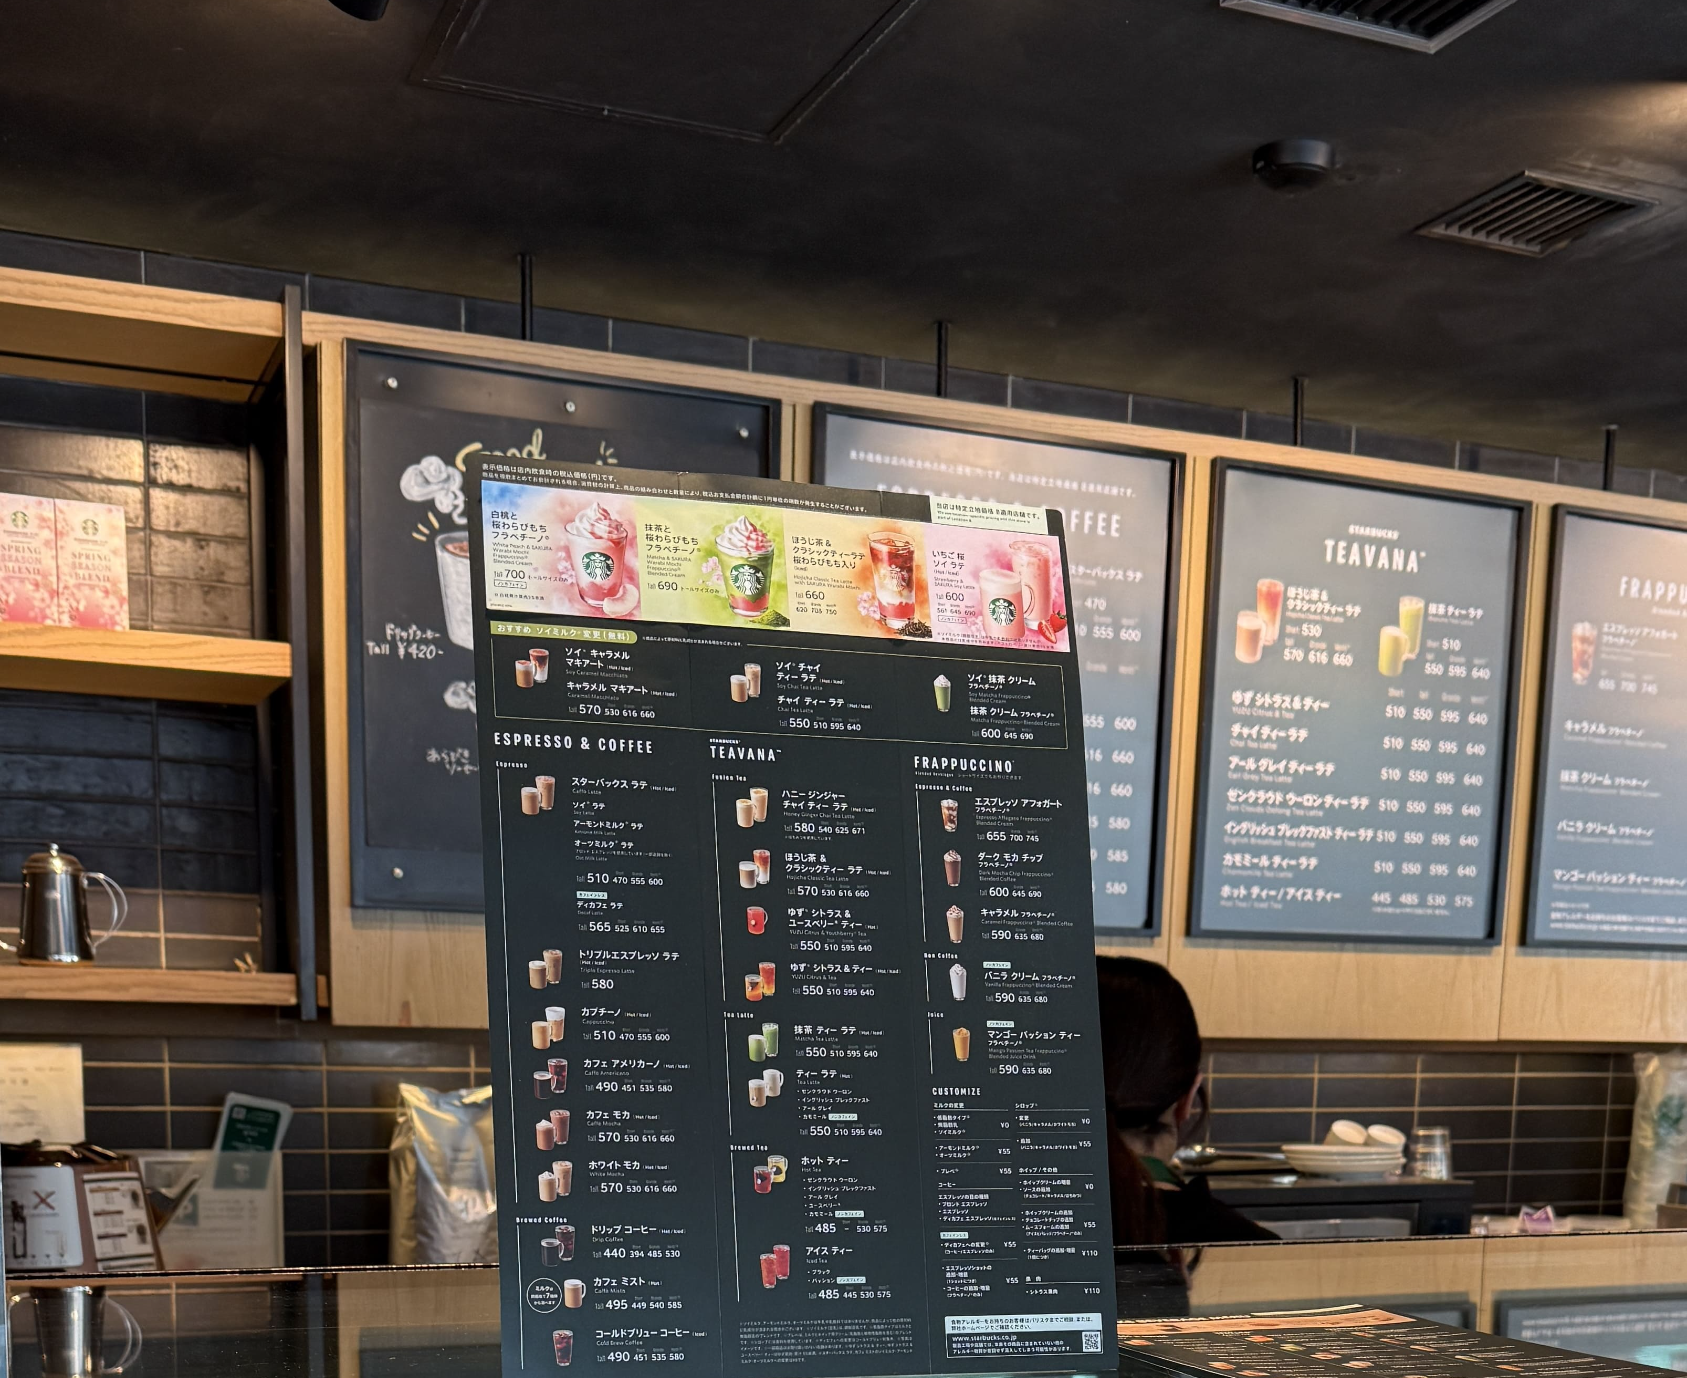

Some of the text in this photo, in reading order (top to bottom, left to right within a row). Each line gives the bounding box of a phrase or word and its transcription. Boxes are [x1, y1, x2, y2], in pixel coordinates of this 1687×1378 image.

[491, 511, 517, 520] 白桃と
[491, 521, 547, 533] 桜わらびもち
[645, 524, 670, 534] 抹茶と
[646, 534, 699, 545] 桜わらびもち
[792, 536, 823, 546] ほうじ茶
[793, 556, 856, 568] 桜わらびもち入り
[505, 570, 525, 579] 700
[658, 582, 678, 591] 690
[805, 591, 825, 600] 660
[946, 592, 964, 601] 600
[1085, 597, 1107, 610] 470
[497, 625, 531, 634] おすすめ
[1302, 624, 1322, 638] 530
[366, 641, 389, 655] Tall
[591, 649, 629, 659] キャラメル
[1284, 648, 1353, 667] 570 616 660
[566, 659, 604, 669] マキアート
[579, 705, 655, 718] 570 530 616 660
[1114, 716, 1137, 730] 600
[494, 732, 653, 754] ESPRESSO & COFFEE
[1231, 722, 1486, 756] チャイ ティー ラテ 510 550 595 640
[572, 778, 647, 789] スターバックス ラテ
[808, 791, 845, 799] ジンジャー
[783, 800, 848, 811] チャイ ティー ラテ
[975, 798, 1062, 808] エスプレッソ アフォガート
[794, 823, 815, 833] 580
[987, 832, 1006, 841] 655
[587, 874, 663, 886] 510 470 555 600
[580, 950, 679, 961] トリプルエスプレッソ ラテ
[581, 1007, 621, 1016] カプチーノ
[591, 1225, 656, 1235] ドリップ コーヒー
[604, 1248, 680, 1258] 440 394 485 530
[596, 1329, 689, 1338] コールドブリュー コーヒー
